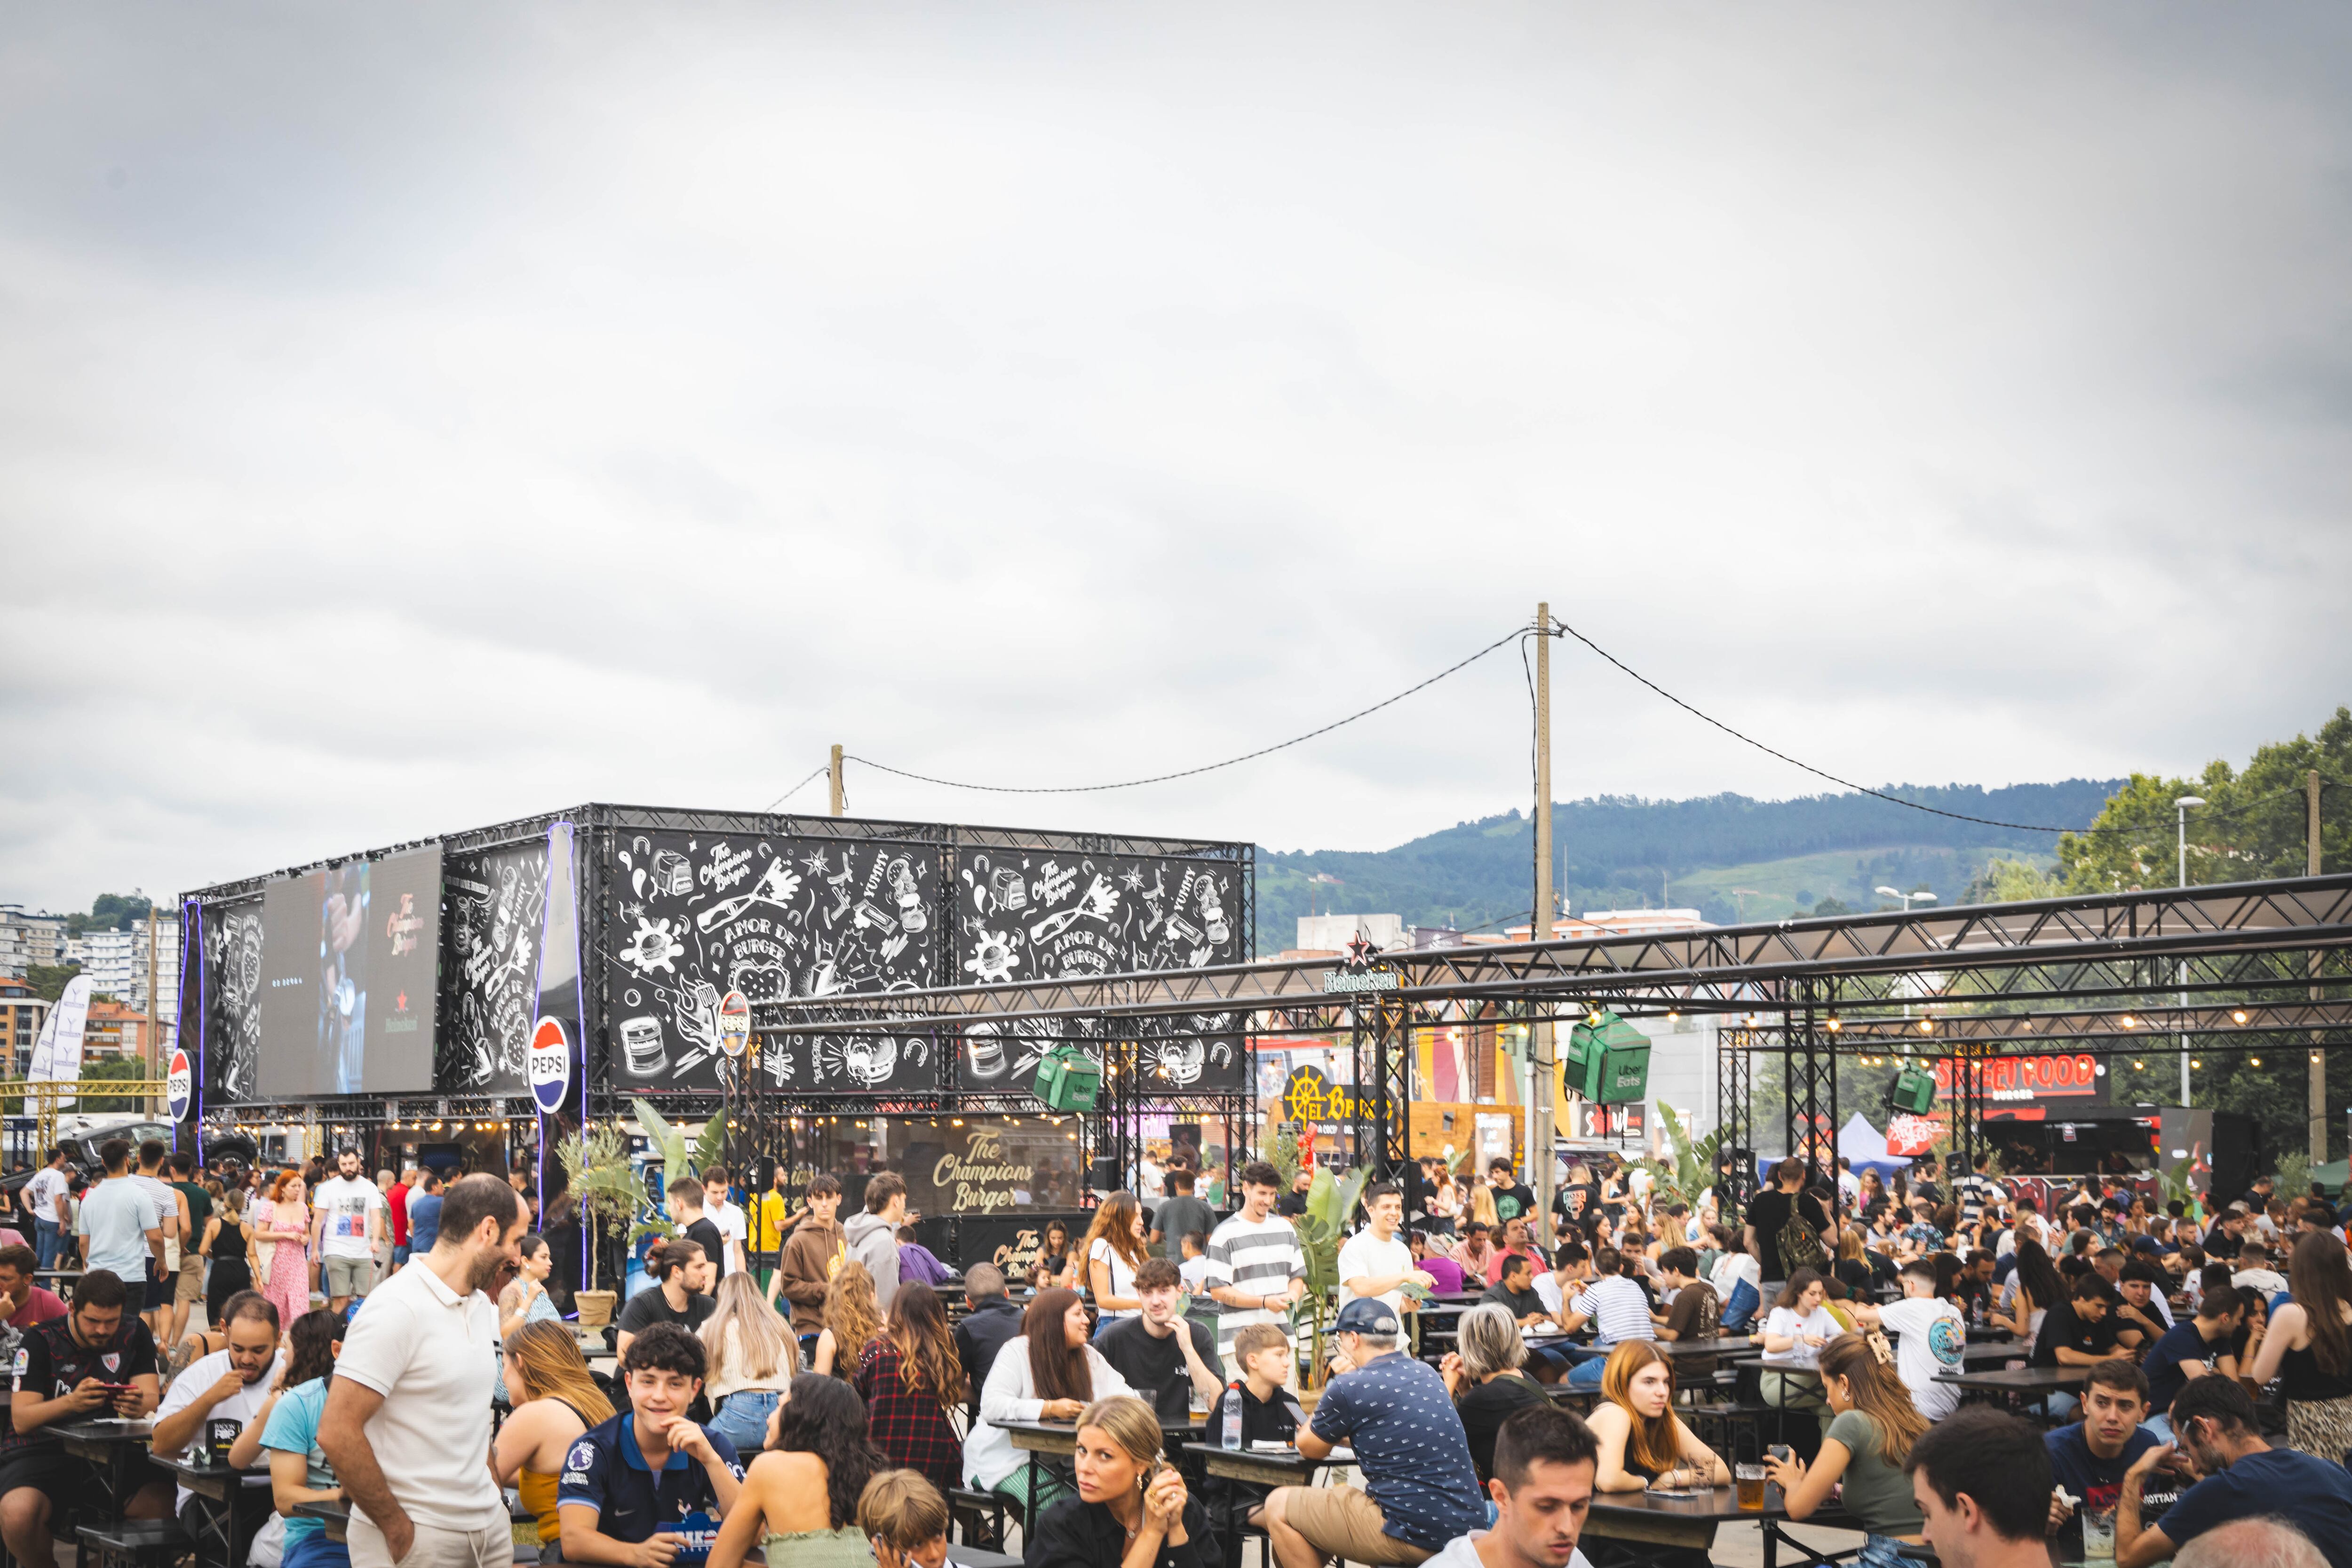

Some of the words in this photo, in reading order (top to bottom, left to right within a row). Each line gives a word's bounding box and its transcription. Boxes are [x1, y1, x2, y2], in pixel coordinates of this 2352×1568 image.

[710, 841, 731, 866] The
[699, 849, 753, 885] Champions
[715, 863, 751, 893] Burger
[863, 848, 889, 898] YUMMY
[1041, 859, 1059, 883] The
[1032, 866, 1078, 900] Champions
[1045, 880, 1076, 907] Burger
[1174, 865, 1196, 912] YUMMY
[724, 918, 771, 945] AMOR
[774, 923, 798, 951] DE
[1054, 931, 1095, 956] AMOR
[1097, 935, 1118, 961] DE
[733, 938, 786, 963] BURGER
[1061, 949, 1108, 972] BURGER
[511, 979, 524, 995] DE
[1323, 969, 1398, 993] Heineken
[721, 1015, 748, 1032] PEPSI
[532, 1056, 566, 1075] PEPSI
[1618, 1064, 1642, 1076] Uber
[2022, 1054, 2097, 1089] FOOD
[1616, 1076, 1641, 1088] Eats
[1993, 1089, 2034, 1101] BURGER
[1309, 1103, 1326, 1121] EL
[965, 1132, 1001, 1164] The
[933, 1153, 1034, 1187] Champions
[952, 1181, 1016, 1215] Burger
[1016, 1229, 1040, 1252] The
[993, 1244, 1037, 1267] Champ
